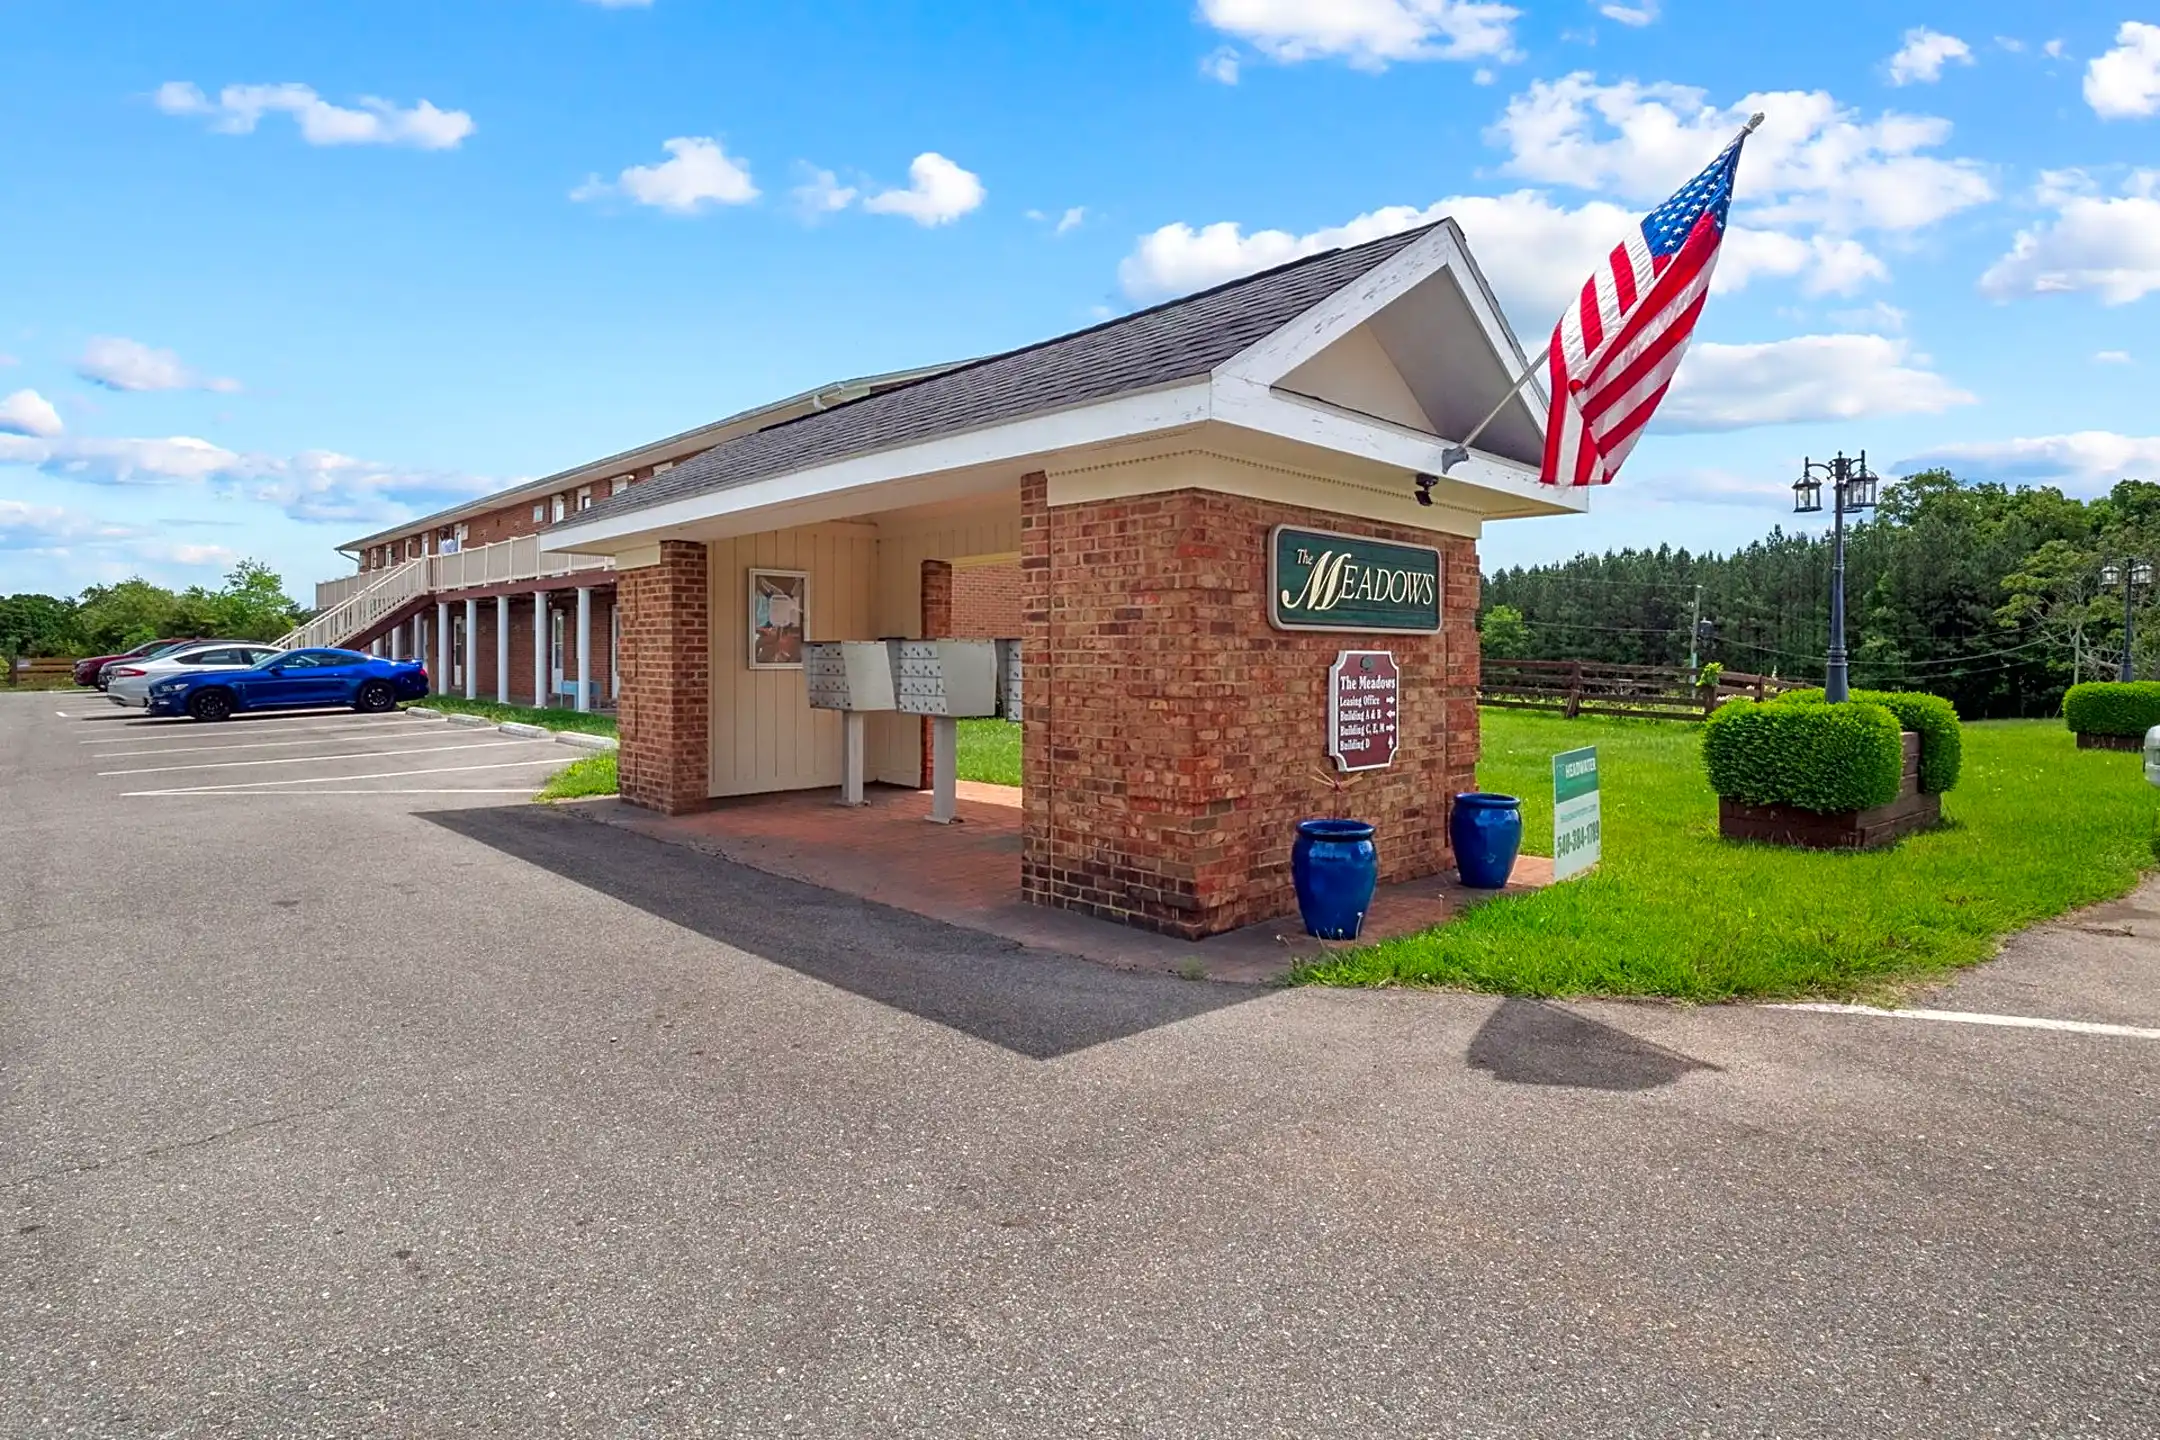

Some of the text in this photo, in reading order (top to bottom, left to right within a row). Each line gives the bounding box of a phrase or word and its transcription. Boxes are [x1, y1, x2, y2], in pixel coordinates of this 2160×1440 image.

[1297, 548, 1314, 566] The
[1281, 551, 1434, 610] MEADOWS
[1340, 675, 1396, 690] The Meadows
[1340, 694, 1380, 708] Leasing Office
[1340, 711, 1364, 722] Building
[1366, 710, 1370, 720] A
[1371, 709, 1376, 720] &
[1340, 725, 1364, 737] Building
[1340, 739, 1364, 751] Building
